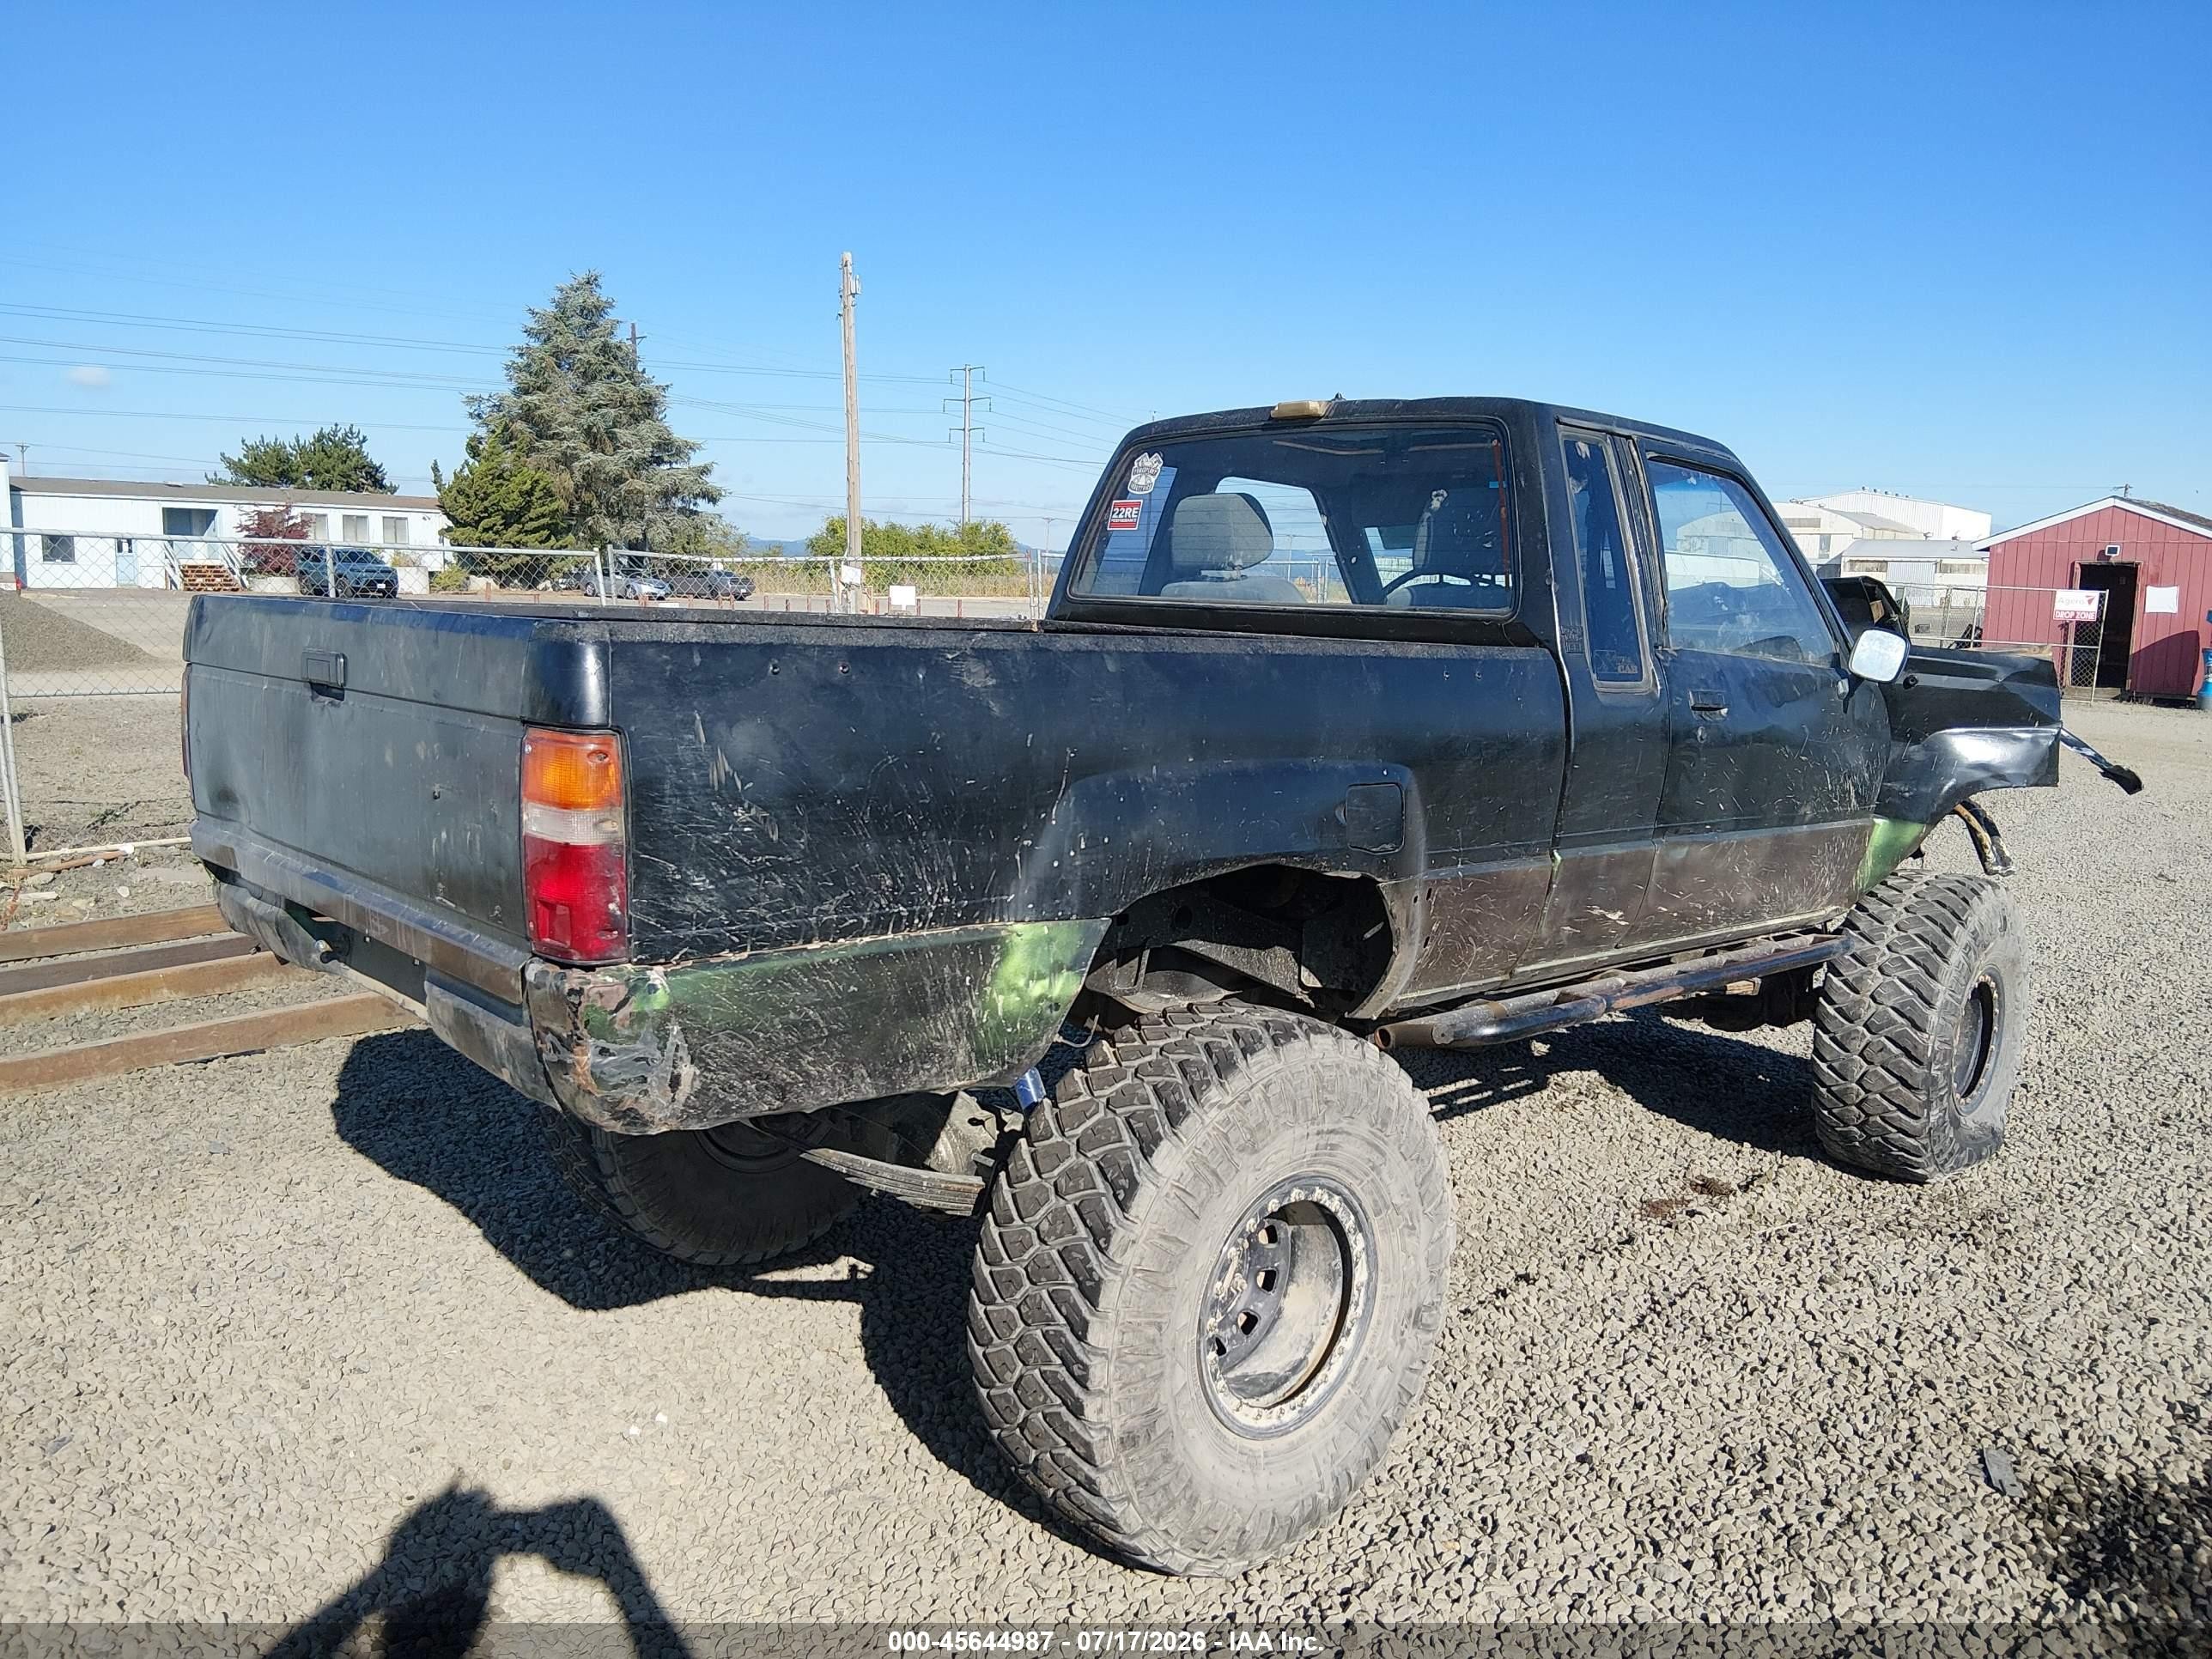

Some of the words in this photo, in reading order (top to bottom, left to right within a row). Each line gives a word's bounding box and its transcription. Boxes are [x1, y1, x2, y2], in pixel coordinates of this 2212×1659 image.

[1112, 507, 1139, 519] 22RE
[2057, 597, 2084, 606] Agero
[2055, 611, 2075, 619] DROP
[2075, 611, 2096, 620] ZONE
